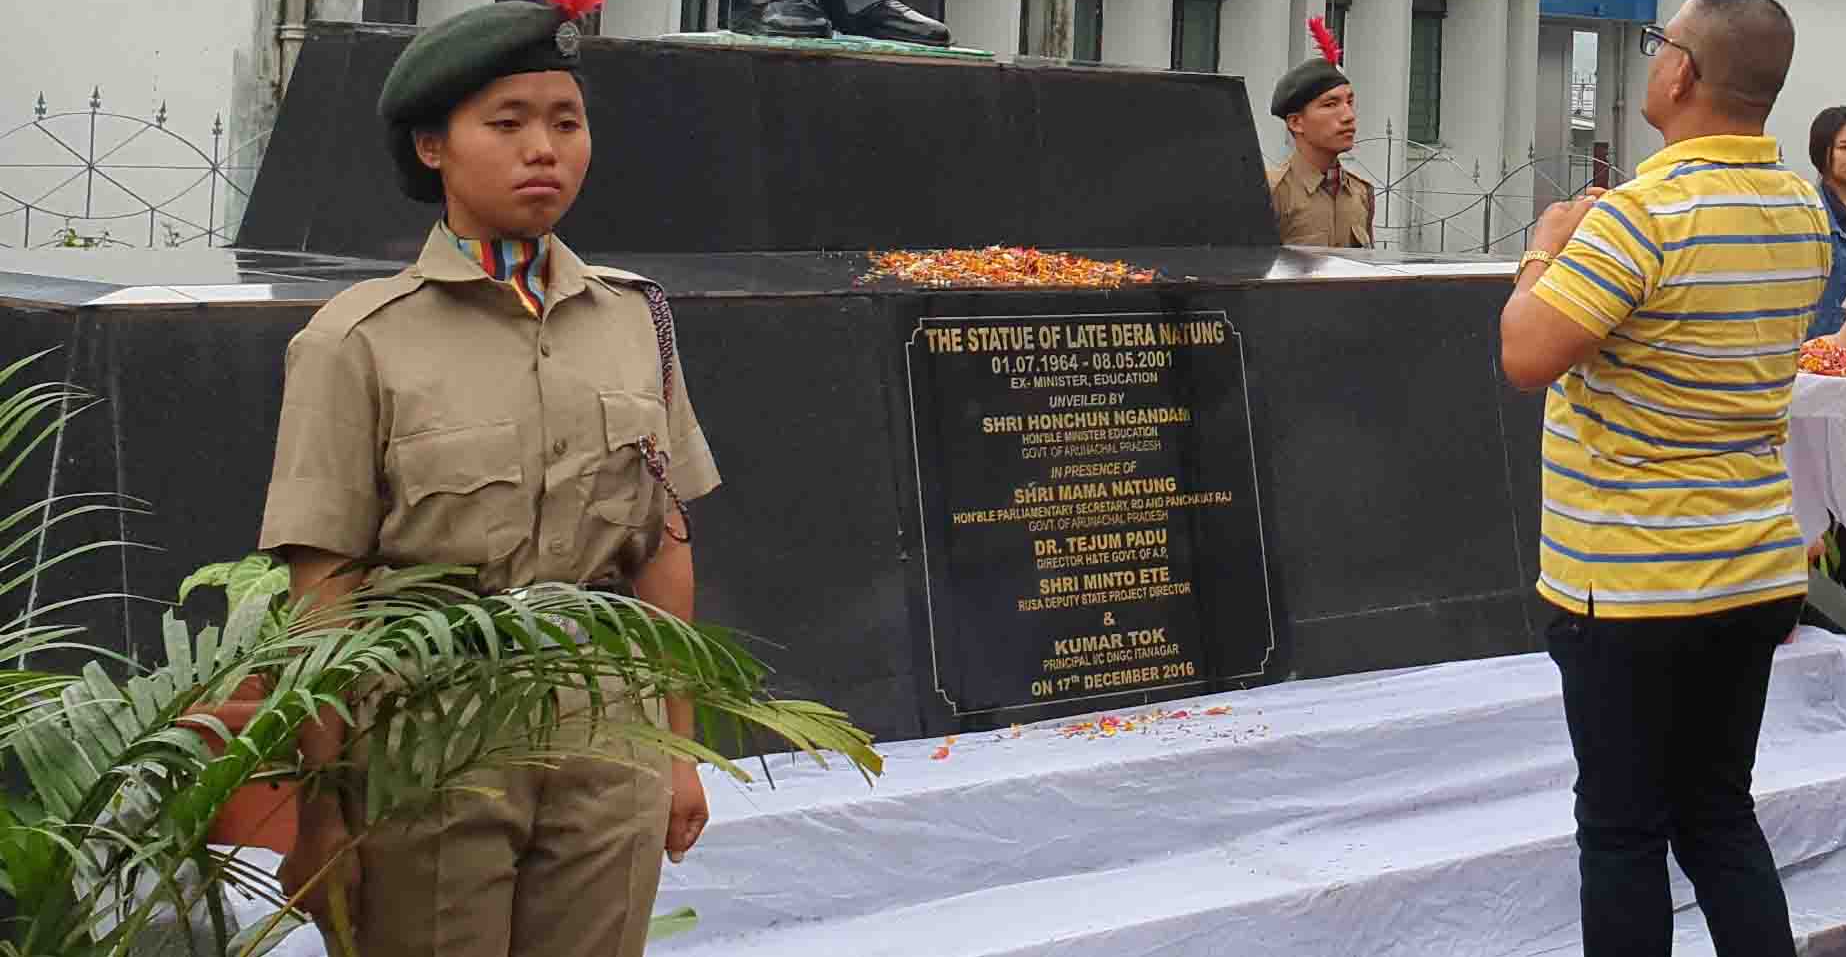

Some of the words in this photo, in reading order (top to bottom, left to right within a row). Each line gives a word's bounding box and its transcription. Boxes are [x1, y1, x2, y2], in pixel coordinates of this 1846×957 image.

[927, 328, 962, 352] THE
[967, 327, 1034, 351] STATUE
[1038, 326, 1061, 349] OF
[1065, 325, 1108, 348] LATE
[1111, 324, 1157, 347] DERA
[1158, 321, 1225, 345] NATUNG
[991, 354, 1079, 374] 01.07.1964
[1092, 350, 1173, 370] 08.05.2001
[1010, 377, 1031, 389] EX-
[1033, 374, 1092, 388] MINISTER,
[1094, 371, 1158, 385] EDUCATION
[1049, 394, 1107, 408] UNVEILED
[1109, 392, 1125, 405] BY
[982, 416, 1022, 433] SHRI
[1028, 411, 1108, 430] HONCHUN
[1064, 429, 1106, 441] MINISTER
[1108, 426, 1158, 439] EDUCATION
[1050, 465, 1062, 479] IN
[1063, 461, 1121, 477] PRESENCE
[1122, 460, 1137, 474] OF
[1013, 485, 1055, 504] SHRI
[1057, 481, 1108, 501] MAMA
[1112, 477, 1176, 496] NATUNG
[1214, 490, 1232, 503] RAJ
[1126, 508, 1169, 524] PRADESH
[1033, 538, 1062, 556] DR.
[1064, 533, 1121, 553] TEJUM
[1126, 529, 1167, 547] PADU
[1036, 555, 1084, 569] DIRECTOR
[1139, 546, 1153, 560] OF
[1039, 576, 1079, 595] SHRI
[1084, 571, 1135, 589] MINTO
[1139, 566, 1170, 584] ETE
[1044, 594, 1080, 609] DEPUTY
[1081, 590, 1107, 604] STATE
[1109, 587, 1147, 602] PROJECT
[1149, 583, 1192, 596] DIRECTOR
[1103, 610, 1115, 627] &
[1054, 633, 1124, 656] KUMAR
[1127, 627, 1167, 646] TOK
[1134, 642, 1179, 660] ITANAGAR
[1031, 680, 1054, 697] ON
[1084, 665, 1160, 689] DECEMBER
